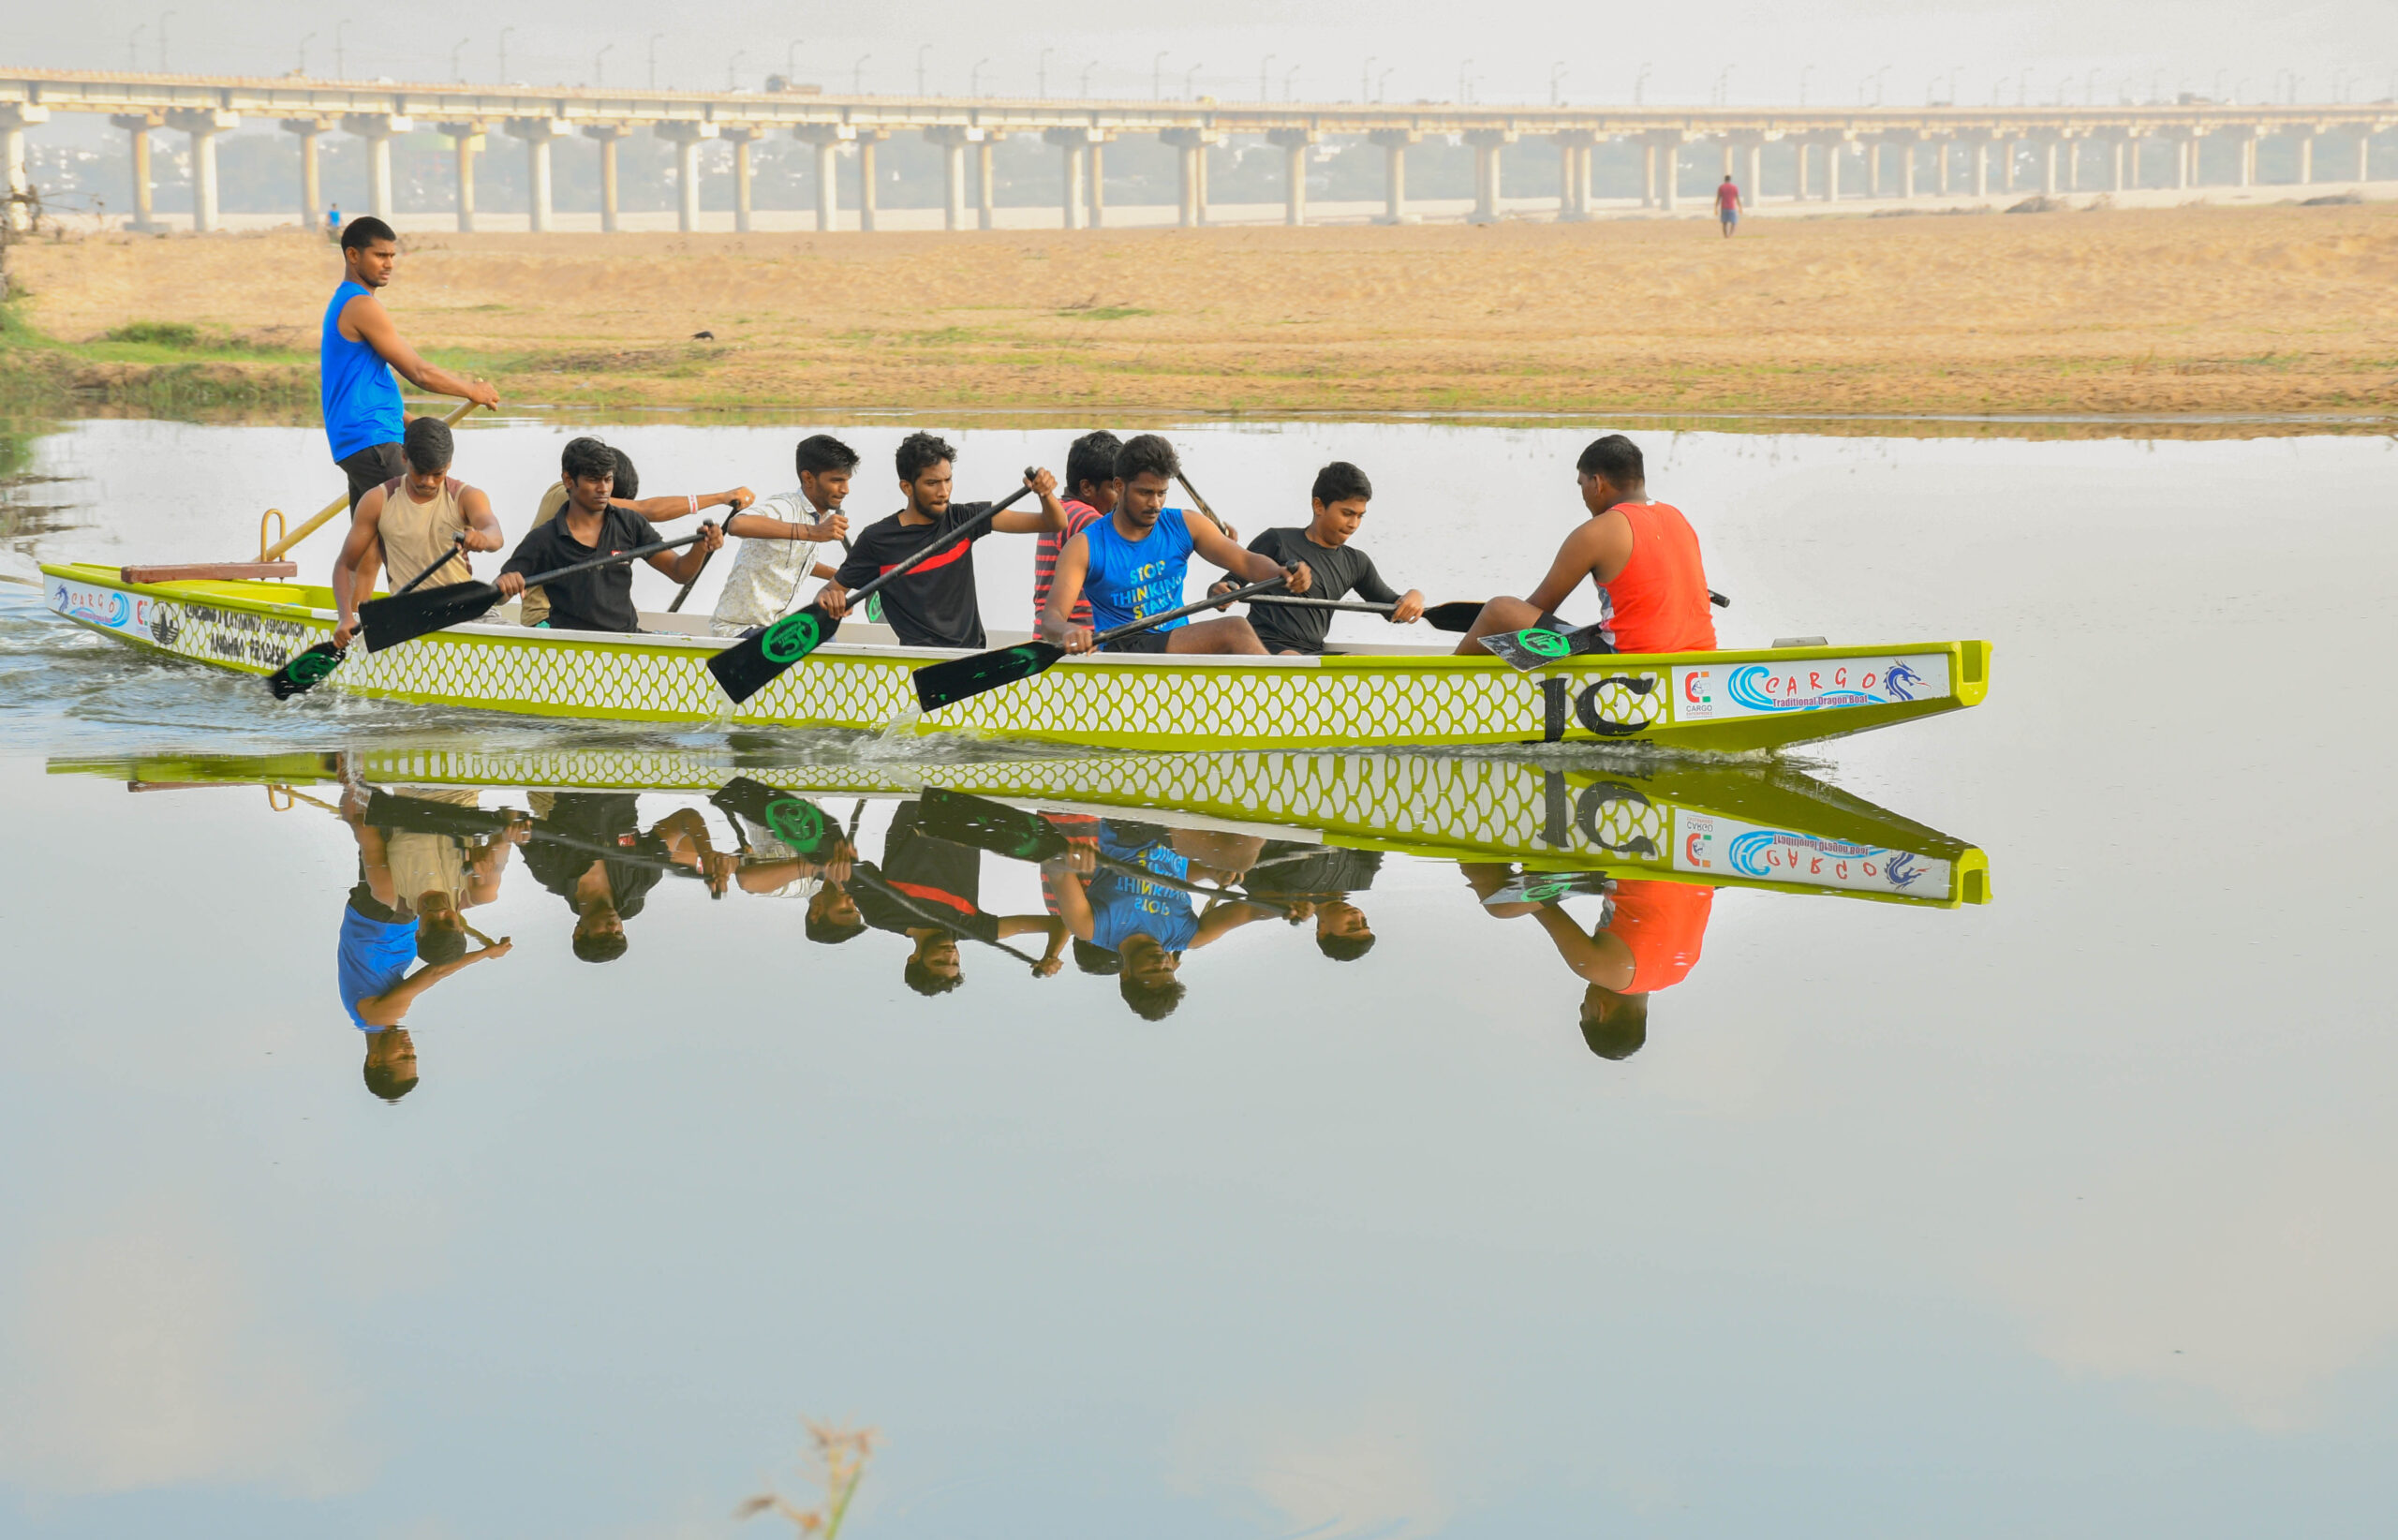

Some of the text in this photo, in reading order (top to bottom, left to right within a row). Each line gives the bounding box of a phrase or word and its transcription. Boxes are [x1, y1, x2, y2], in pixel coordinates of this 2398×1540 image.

[1130, 560, 1166, 585] STOP
[1110, 572, 1182, 606] THINKING
[71, 592, 115, 613] CARGO
[1766, 667, 1876, 697] CARGO
[1772, 694, 1869, 707] Traditional Dragon Boat
